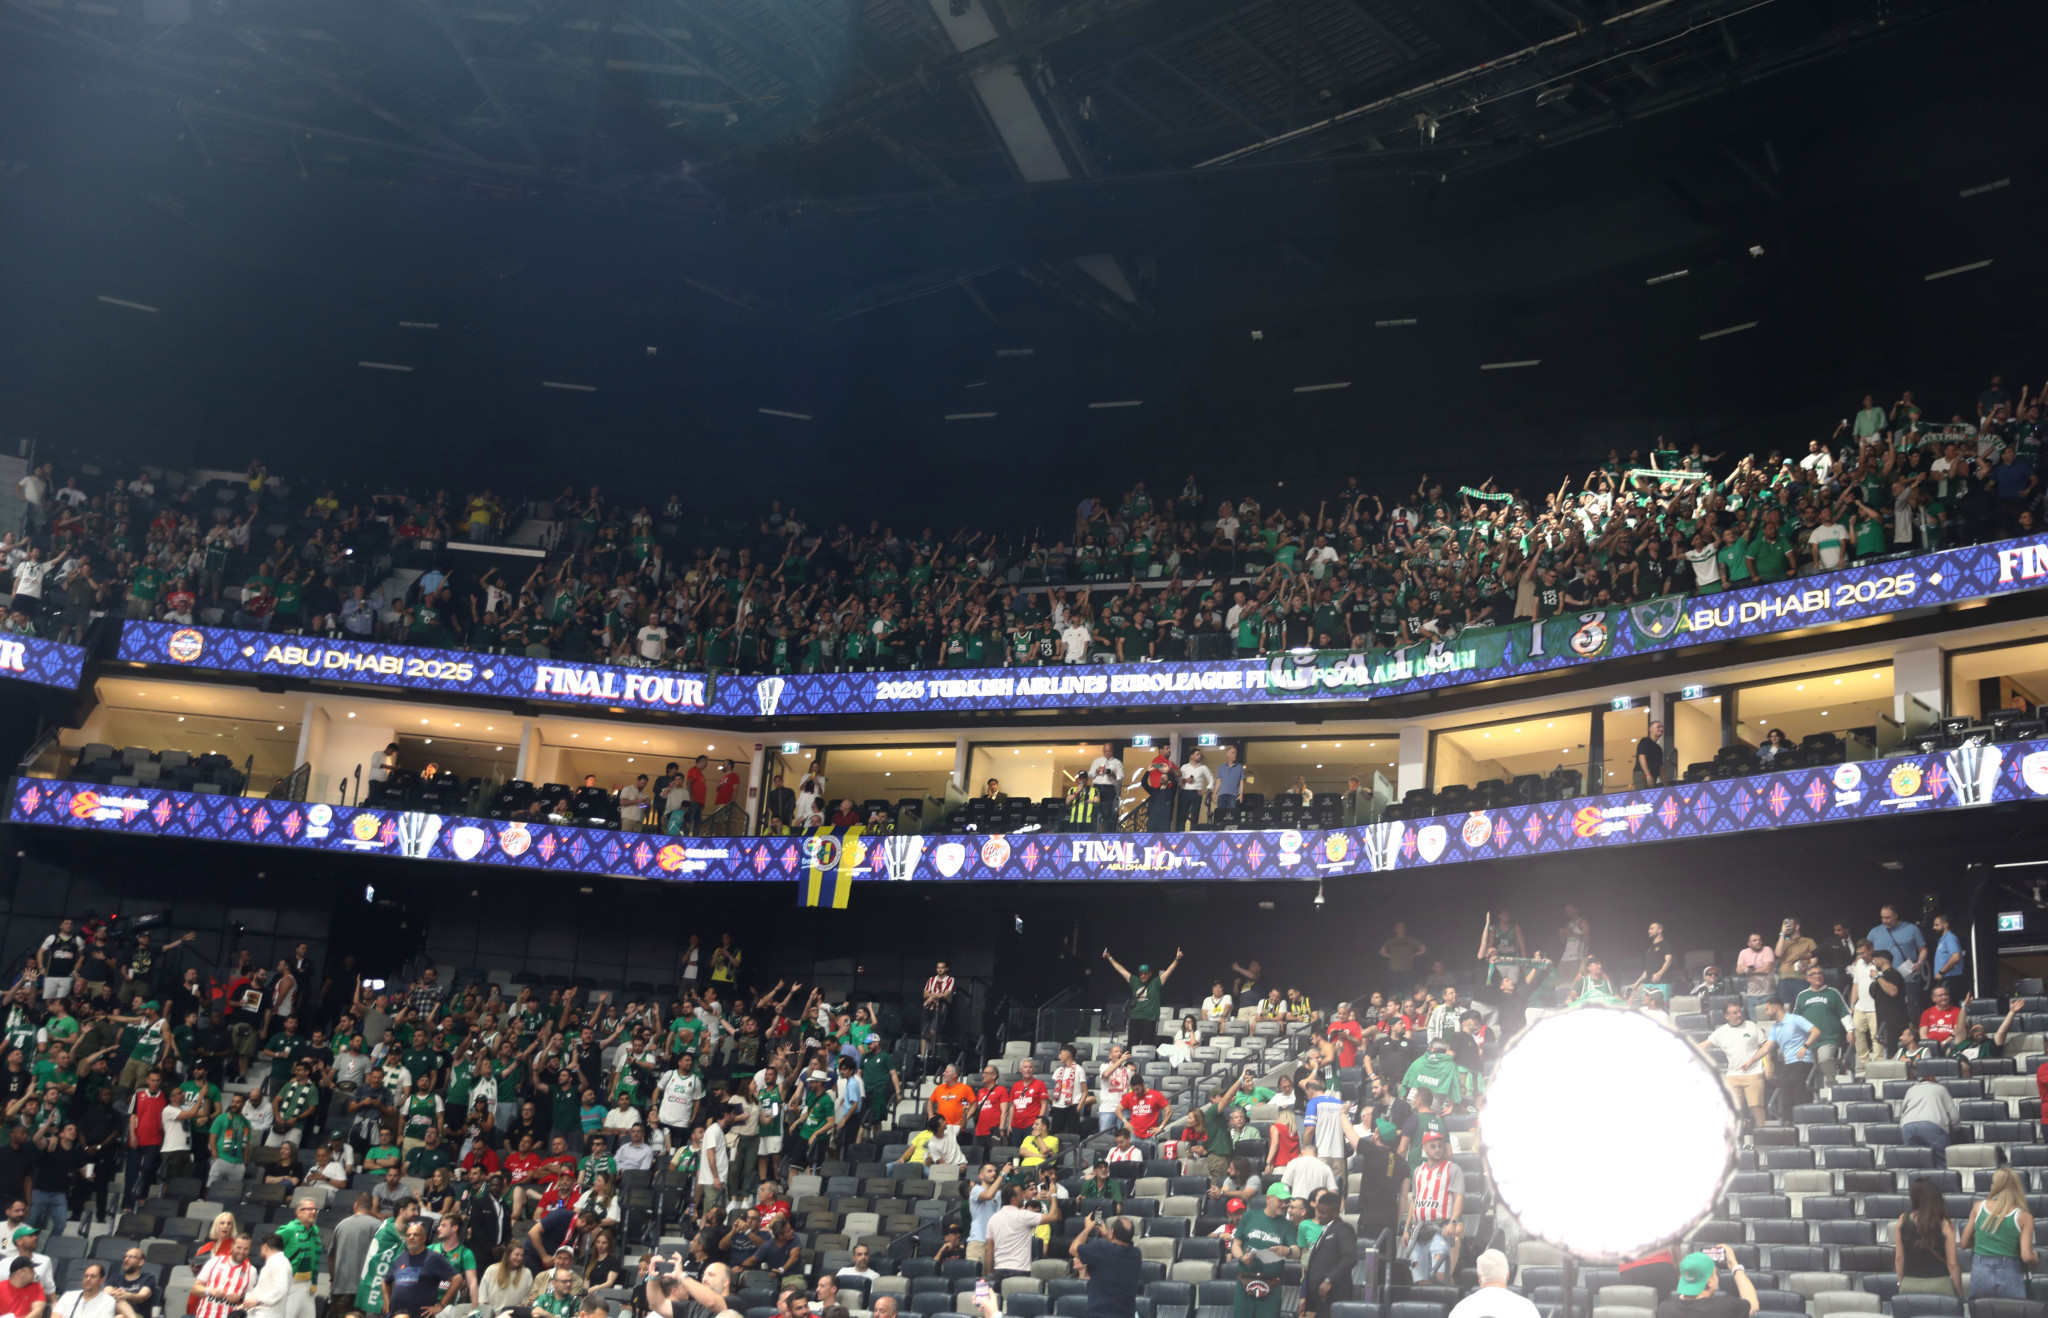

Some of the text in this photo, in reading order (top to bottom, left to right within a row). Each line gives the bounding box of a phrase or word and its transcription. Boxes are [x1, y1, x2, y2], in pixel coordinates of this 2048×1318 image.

[1674, 573, 1916, 635] ABU DHABI 2025
[0, 640, 26, 672] R
[264, 644, 473, 682] ABU DHABI 2025
[534, 666, 619, 698] FINAL
[624, 673, 705, 706] FOUR
[876, 681, 925, 700] 2025
[927, 678, 1014, 699] TURKISH
[1016, 674, 1108, 696] AIRLINES
[1110, 671, 1243, 693] EUROLEAGUE
[1071, 840, 1139, 864] FINAL
[1805, 995, 1828, 1005] ADIDAS
[674, 1084, 686, 1093] 25
[1417, 1074, 1440, 1086] ATHENS
